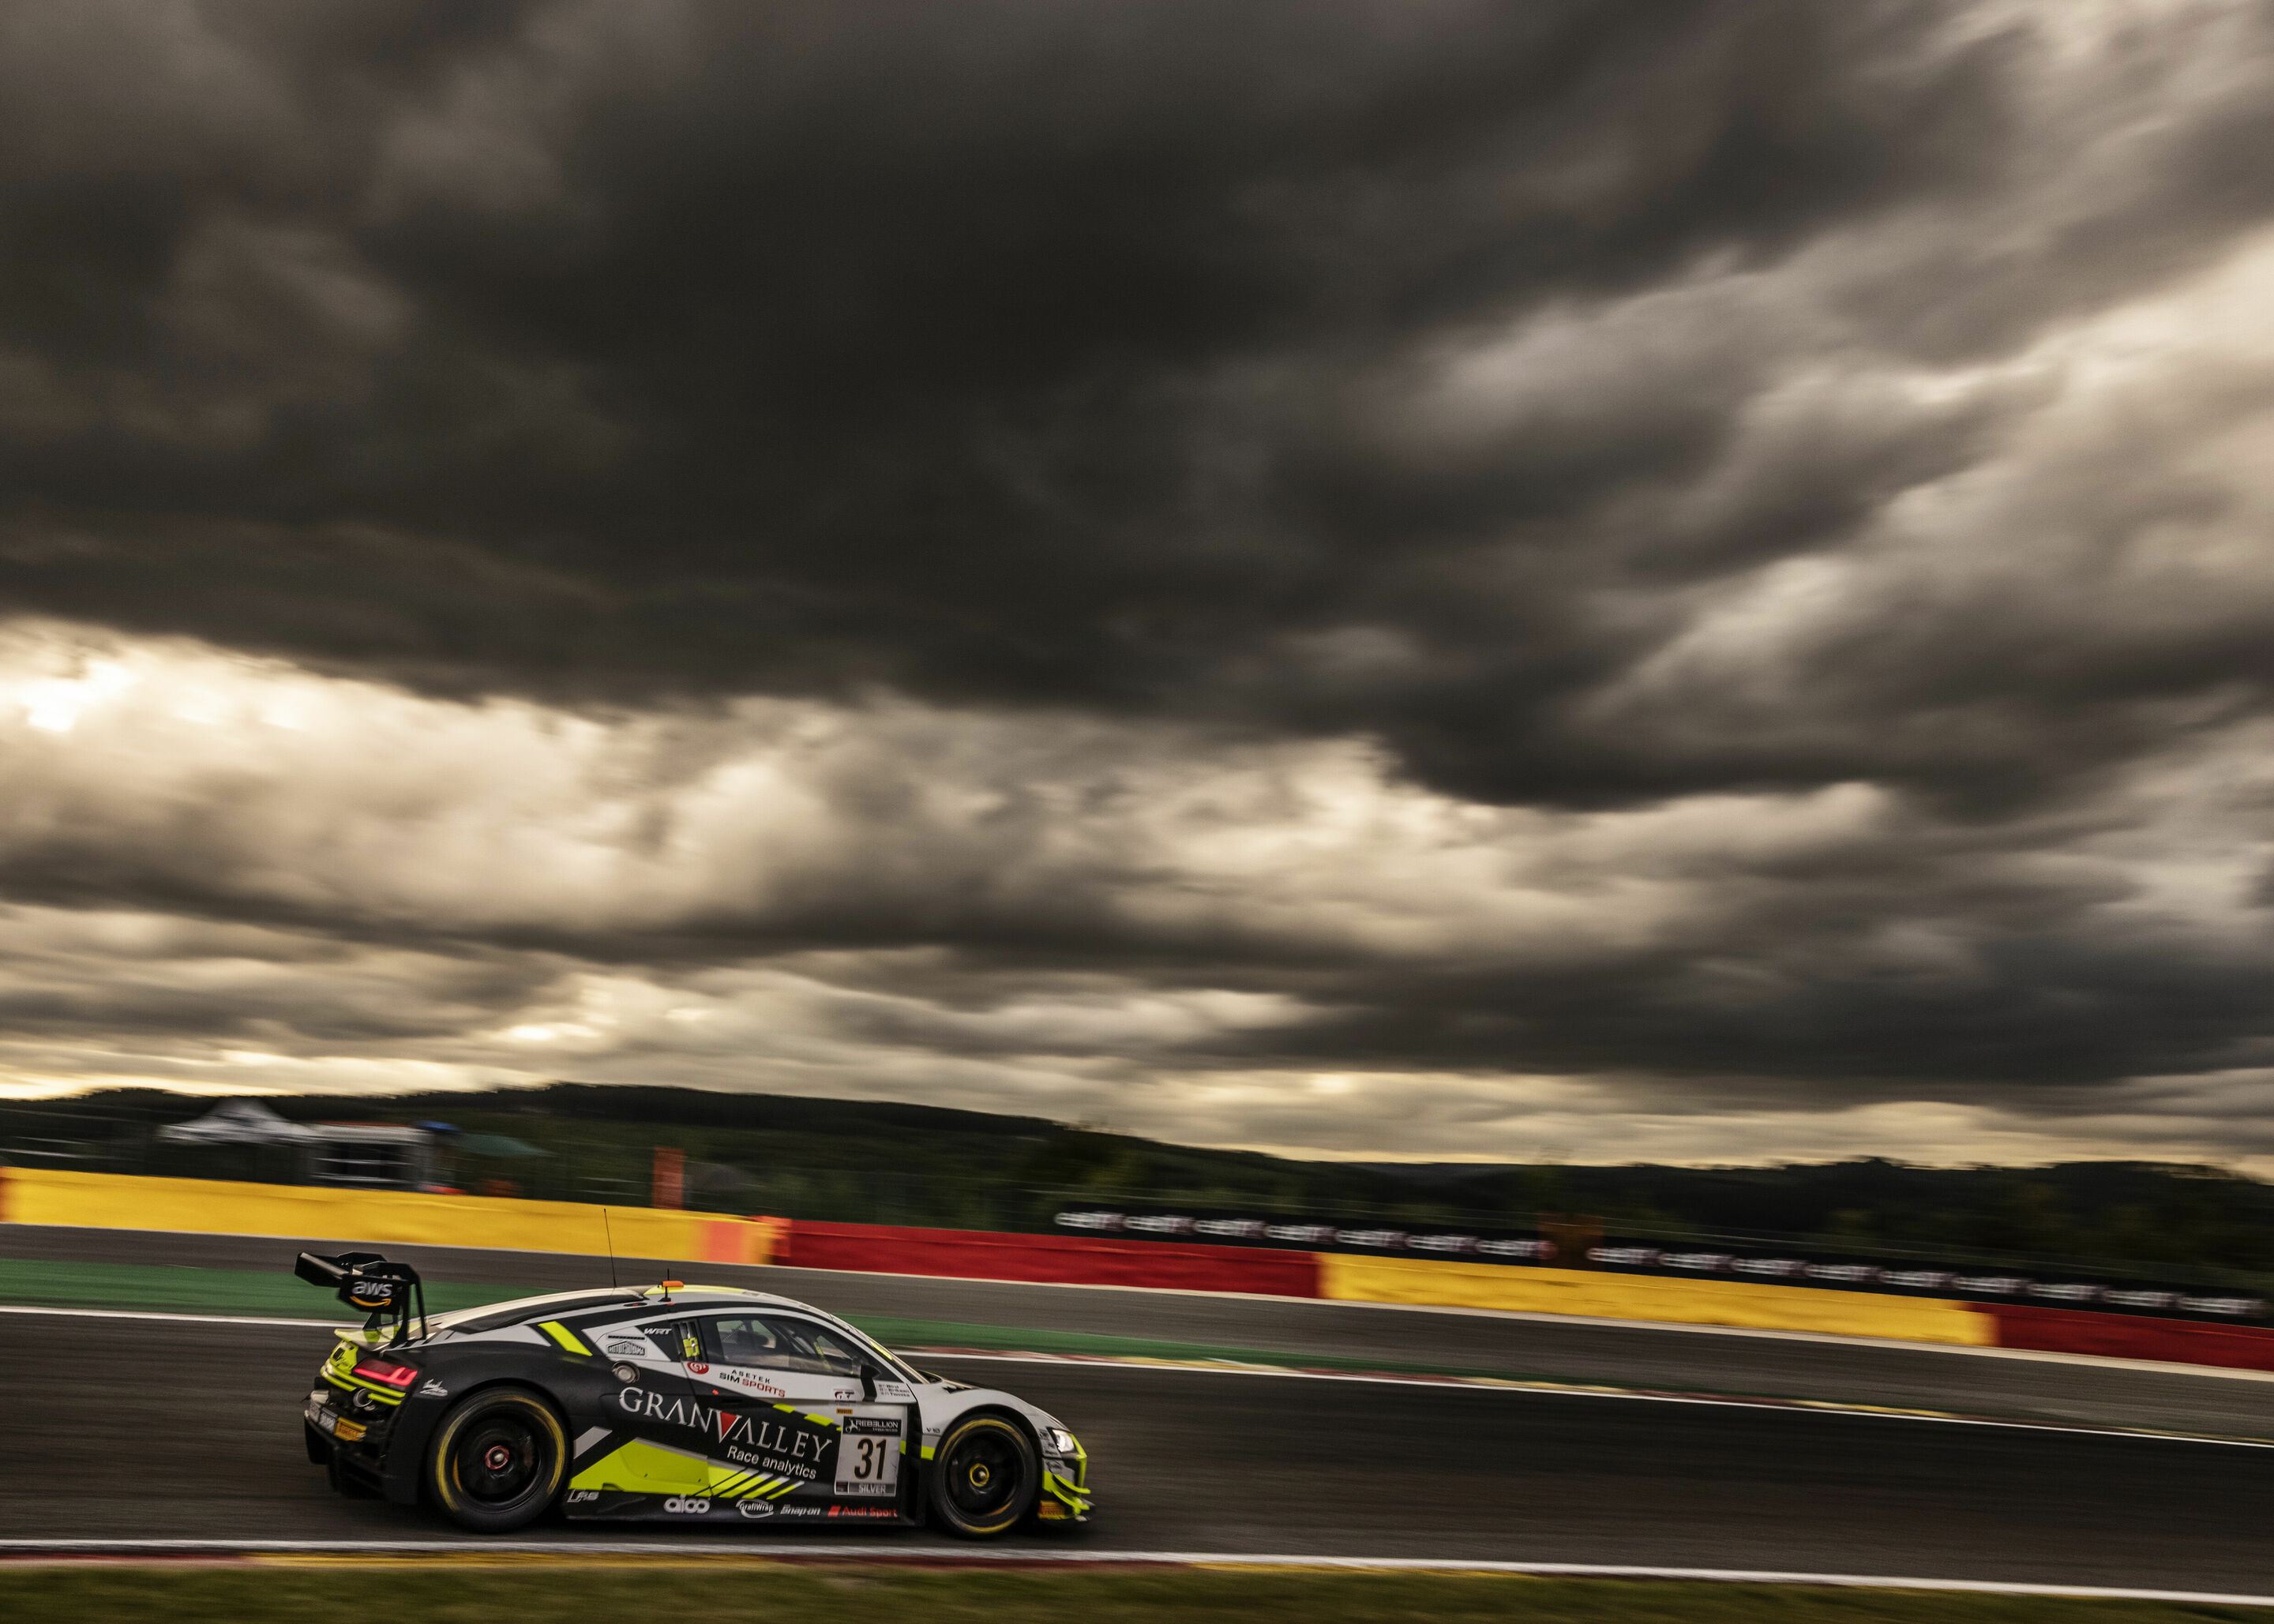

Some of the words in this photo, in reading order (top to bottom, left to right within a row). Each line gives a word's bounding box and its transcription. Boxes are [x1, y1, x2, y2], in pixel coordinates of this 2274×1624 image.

[352, 1281, 392, 1296] aws
[731, 1370, 771, 1384] ASETEK
[719, 1372, 741, 1384] SIM
[742, 1378, 786, 1397] SPORTS
[619, 1386, 832, 1462] GRANVALLEY
[856, 1420, 899, 1428] REBELLION
[727, 1446, 759, 1465] Race
[762, 1456, 816, 1480] analytics
[854, 1437, 887, 1480] 31
[858, 1483, 886, 1493] SILVER
[739, 1502, 774, 1512] GrafiWrap
[780, 1504, 820, 1516] Snap-on
[842, 1506, 867, 1517] Audi
[869, 1507, 898, 1518] Sport
